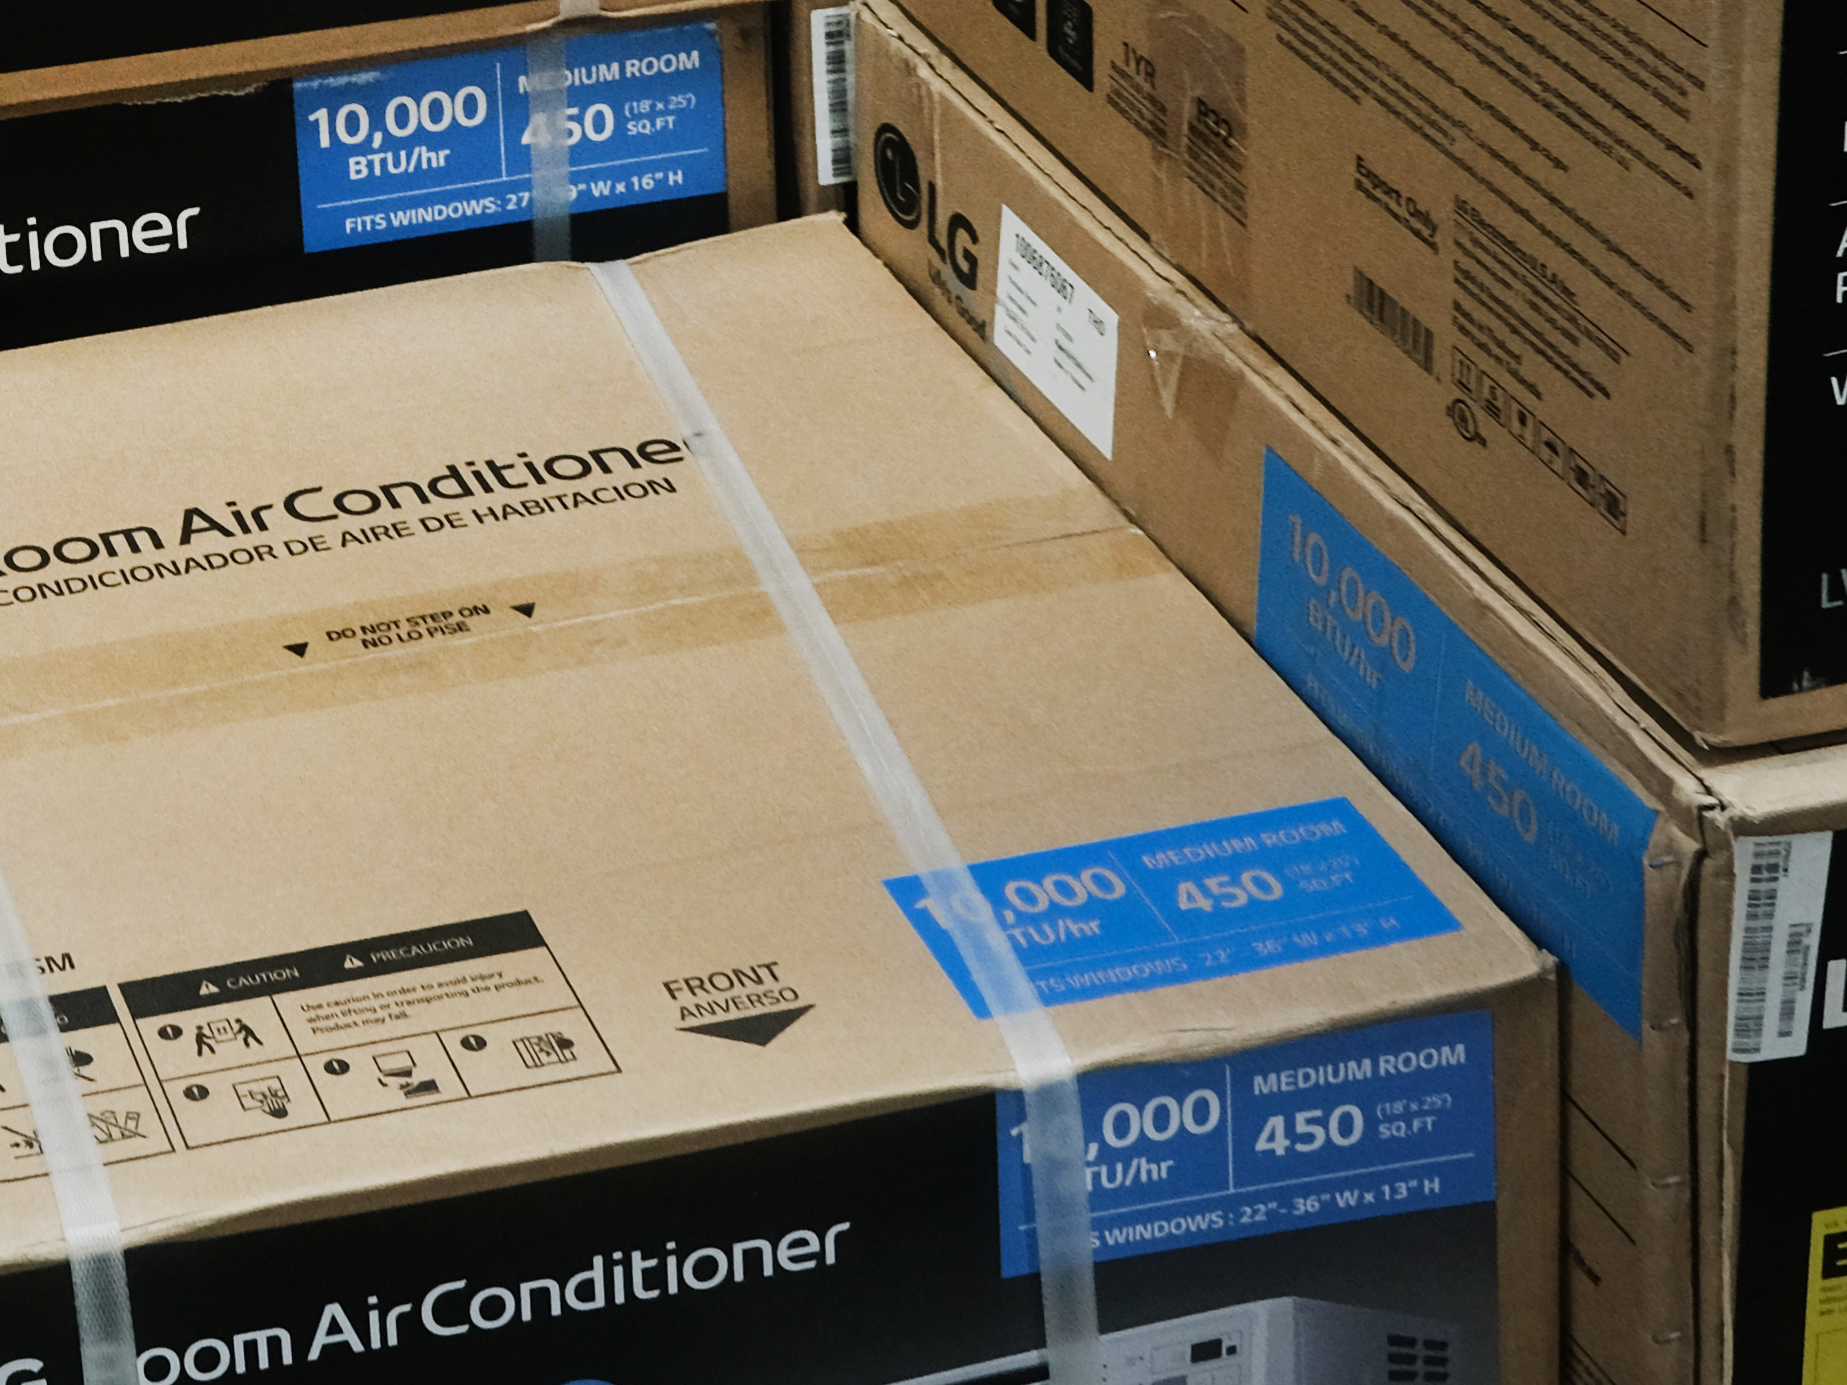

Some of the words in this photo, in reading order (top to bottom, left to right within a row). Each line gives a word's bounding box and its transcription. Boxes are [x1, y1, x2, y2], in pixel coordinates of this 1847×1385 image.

[308, 84, 488, 149] 10,000
[348, 146, 451, 180] BTU/hr
[345, 213, 387, 234] FITS
[390, 196, 502, 228] WINDOWS:
[926, 180, 980, 290] LG
[282, 533, 333, 557] DE
[339, 520, 417, 547] AIRE
[419, 511, 469, 533] DE
[472, 475, 678, 526] HABITACION
[1289, 513, 1416, 672] 10,000
[325, 627, 357, 642] DO
[359, 620, 402, 636] NOT
[405, 610, 454, 628] STEP
[458, 603, 491, 619] ON
[361, 634, 393, 650] NO
[396, 630, 423, 644] LO
[428, 620, 472, 639] PISE
[1176, 869, 1285, 913] 450
[370, 935, 474, 965] PRECAUCION
[225, 966, 301, 991] CAUTION
[300, 1002, 325, 1013] Use
[325, 994, 371, 1009] caution
[371, 992, 384, 1002] in
[384, 985, 419, 1000] order
[420, 982, 436, 992] to
[435, 975, 469, 990] avoid
[469, 970, 505, 985] injury
[306, 1011, 339, 1024] when
[340, 1003, 378, 1020] lifting
[378, 1004, 393, 1012] or
[393, 986, 470, 1011] transporting
[470, 984, 493, 997] the
[493, 975, 546, 996] product.
[660, 961, 784, 1000] FRONT
[675, 985, 800, 1025] ANVERSO
[1252, 1058, 1372, 1096] MEDIUM
[1377, 1043, 1467, 1078] ROOM
[1254, 1102, 1366, 1157] 450
